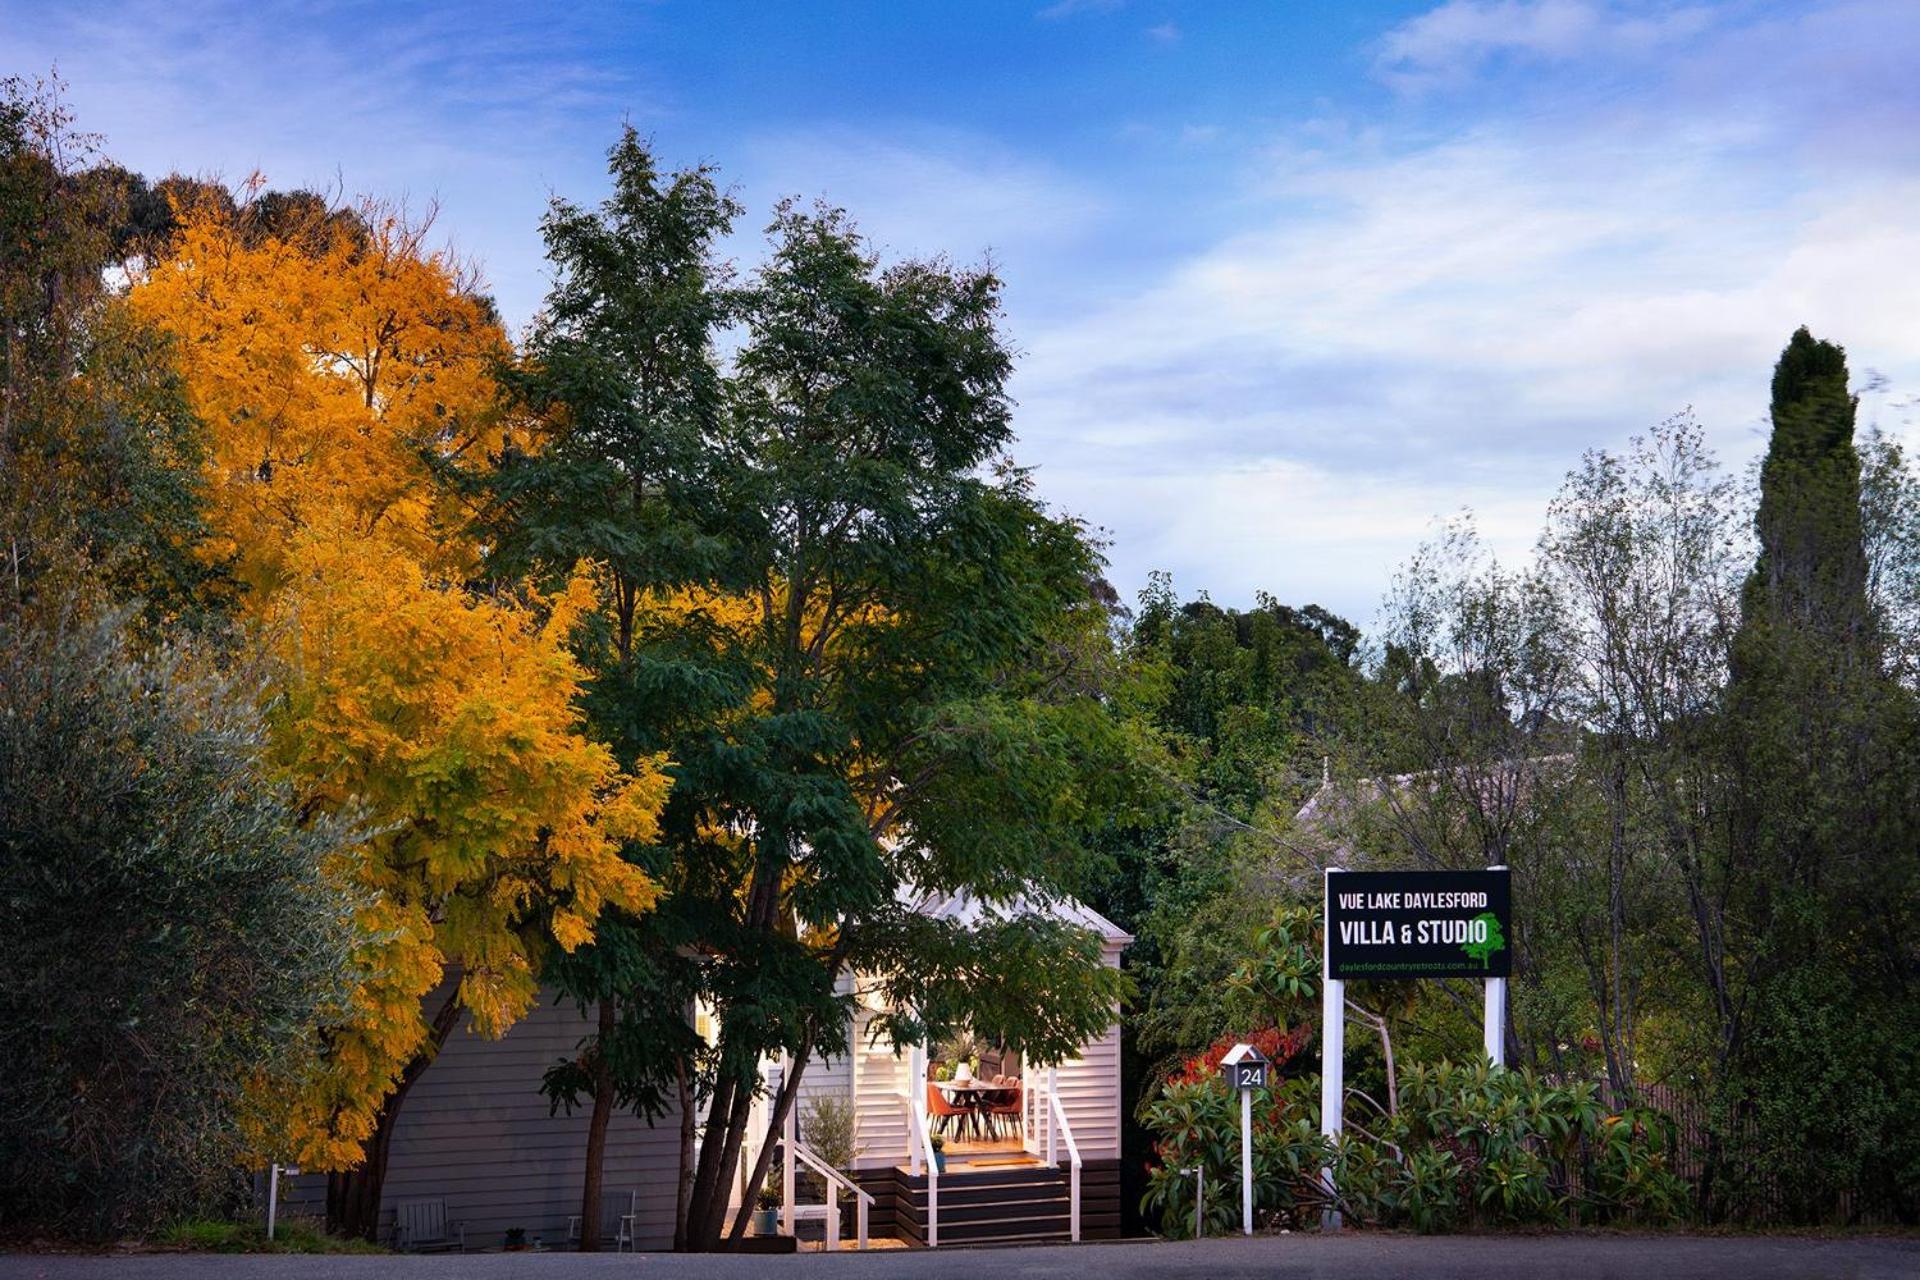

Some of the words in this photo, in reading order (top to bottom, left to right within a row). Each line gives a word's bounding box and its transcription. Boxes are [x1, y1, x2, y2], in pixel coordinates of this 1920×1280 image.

[1339, 893, 1364, 909] VUE
[1368, 893, 1400, 909] LAKE
[1404, 892, 1487, 908] DAYLESFORD
[1340, 921, 1395, 945] VILLA
[1401, 924, 1412, 944] &
[1417, 919, 1487, 944] STUDIO
[1241, 1068, 1262, 1085] 24
